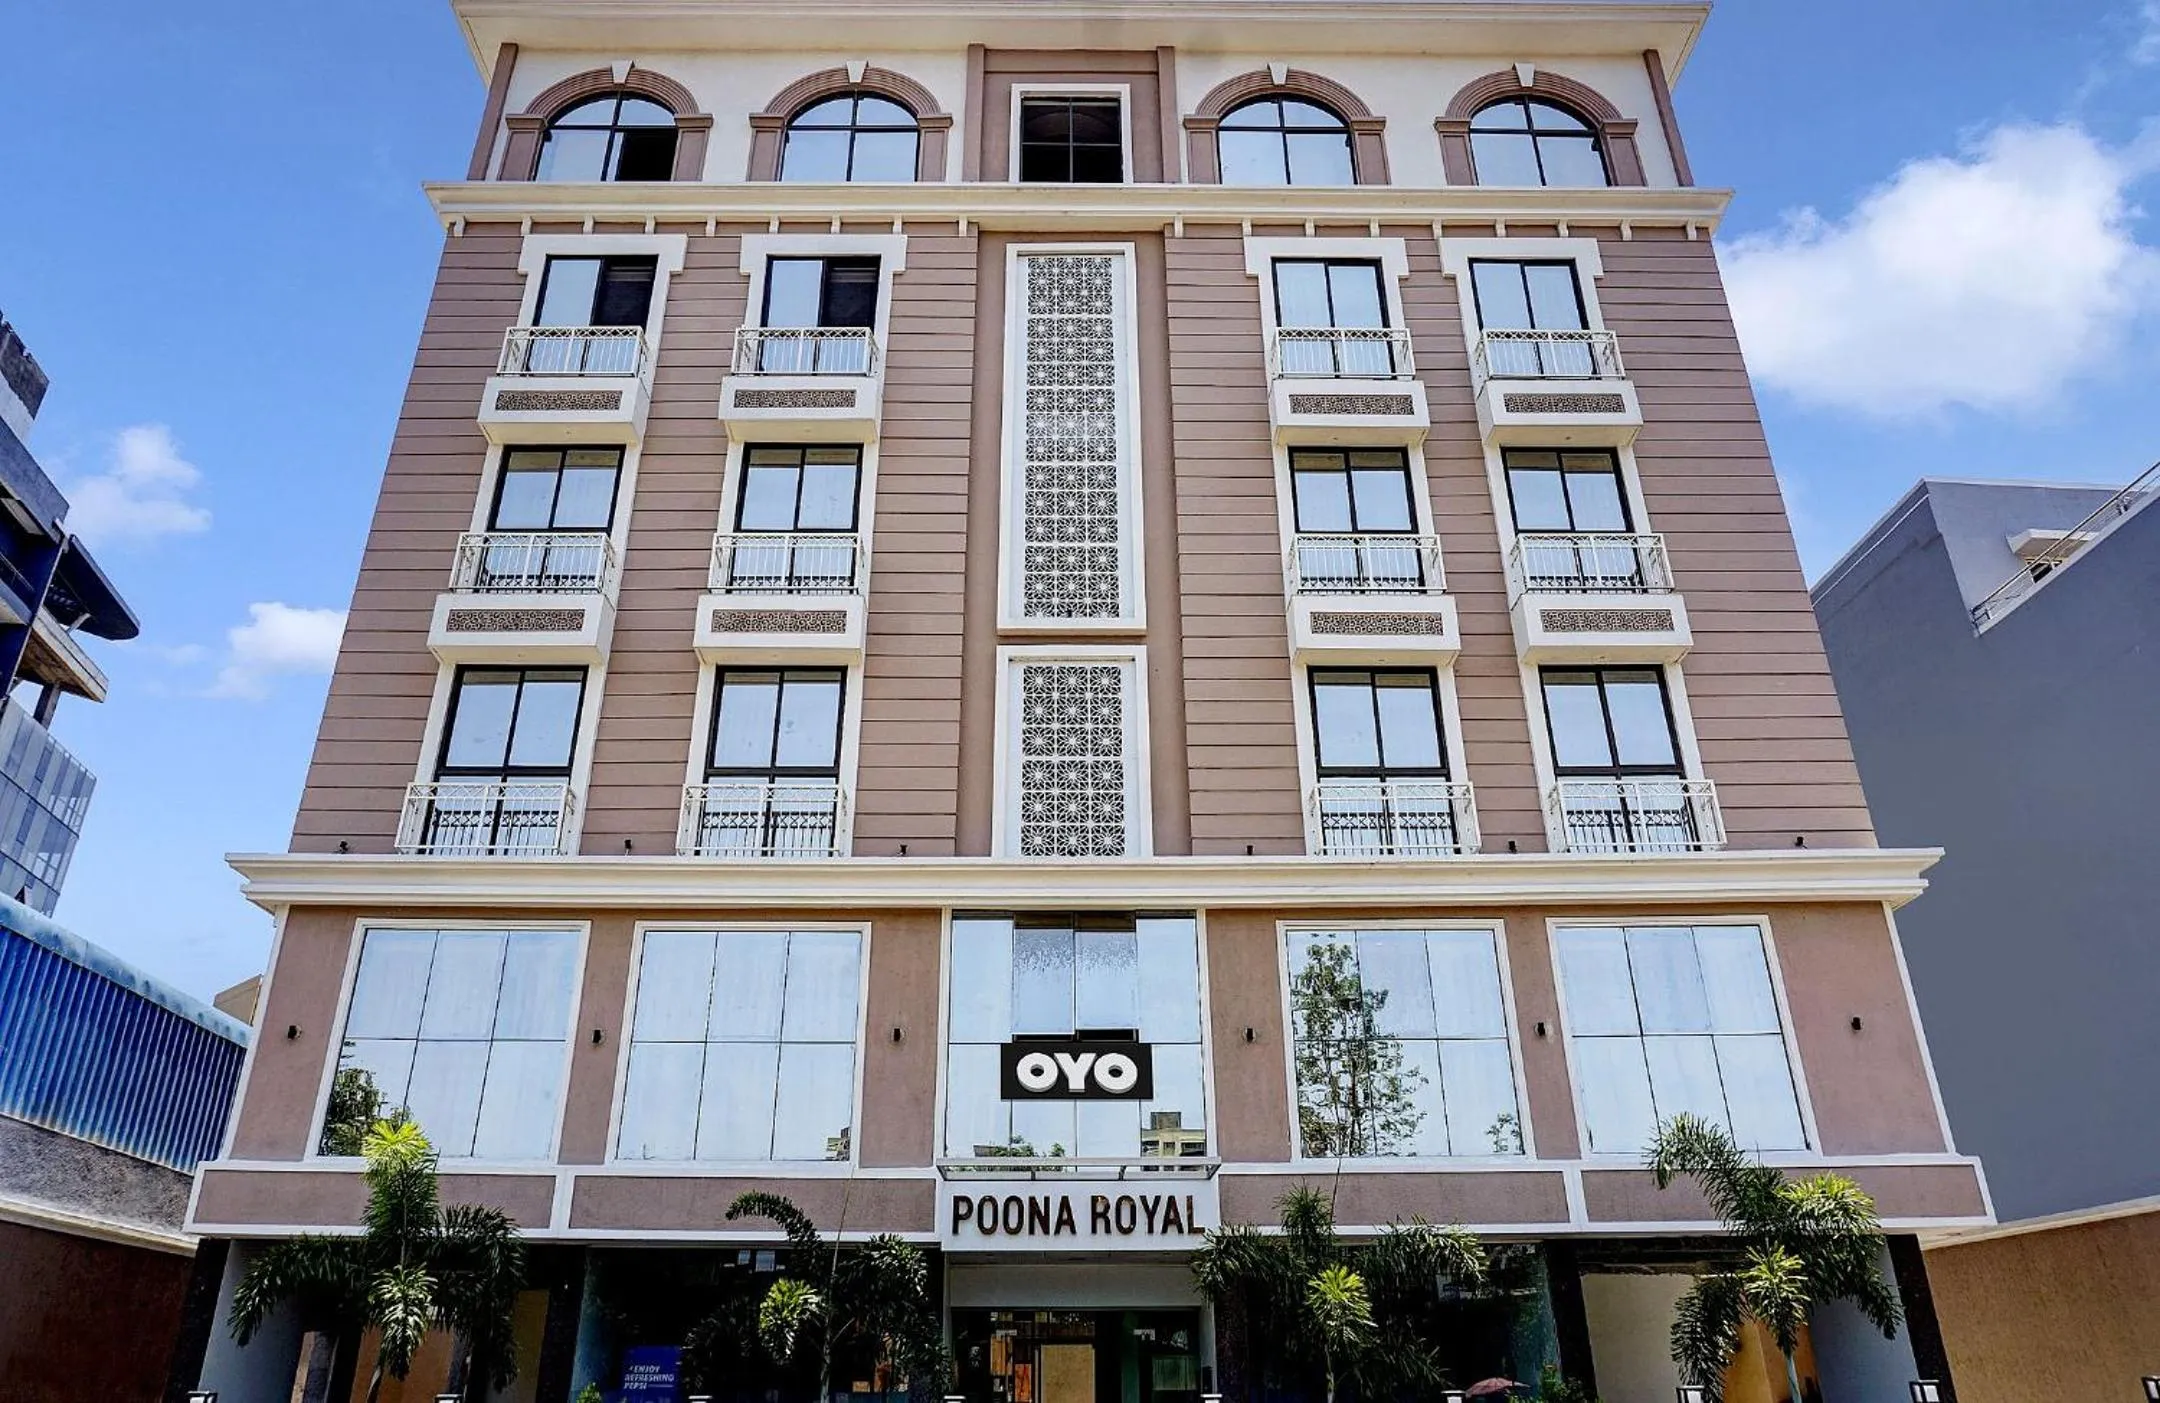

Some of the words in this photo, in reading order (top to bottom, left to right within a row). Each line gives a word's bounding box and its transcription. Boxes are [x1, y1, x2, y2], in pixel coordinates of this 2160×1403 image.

[1016, 1052, 1138, 1094] OYO
[952, 1195, 1077, 1236] POONA
[1090, 1195, 1206, 1236] ROYAL
[633, 1365, 661, 1373] ENJOY
[624, 1373, 675, 1382] REFRESHING
[623, 1382, 648, 1390] PEPSI
